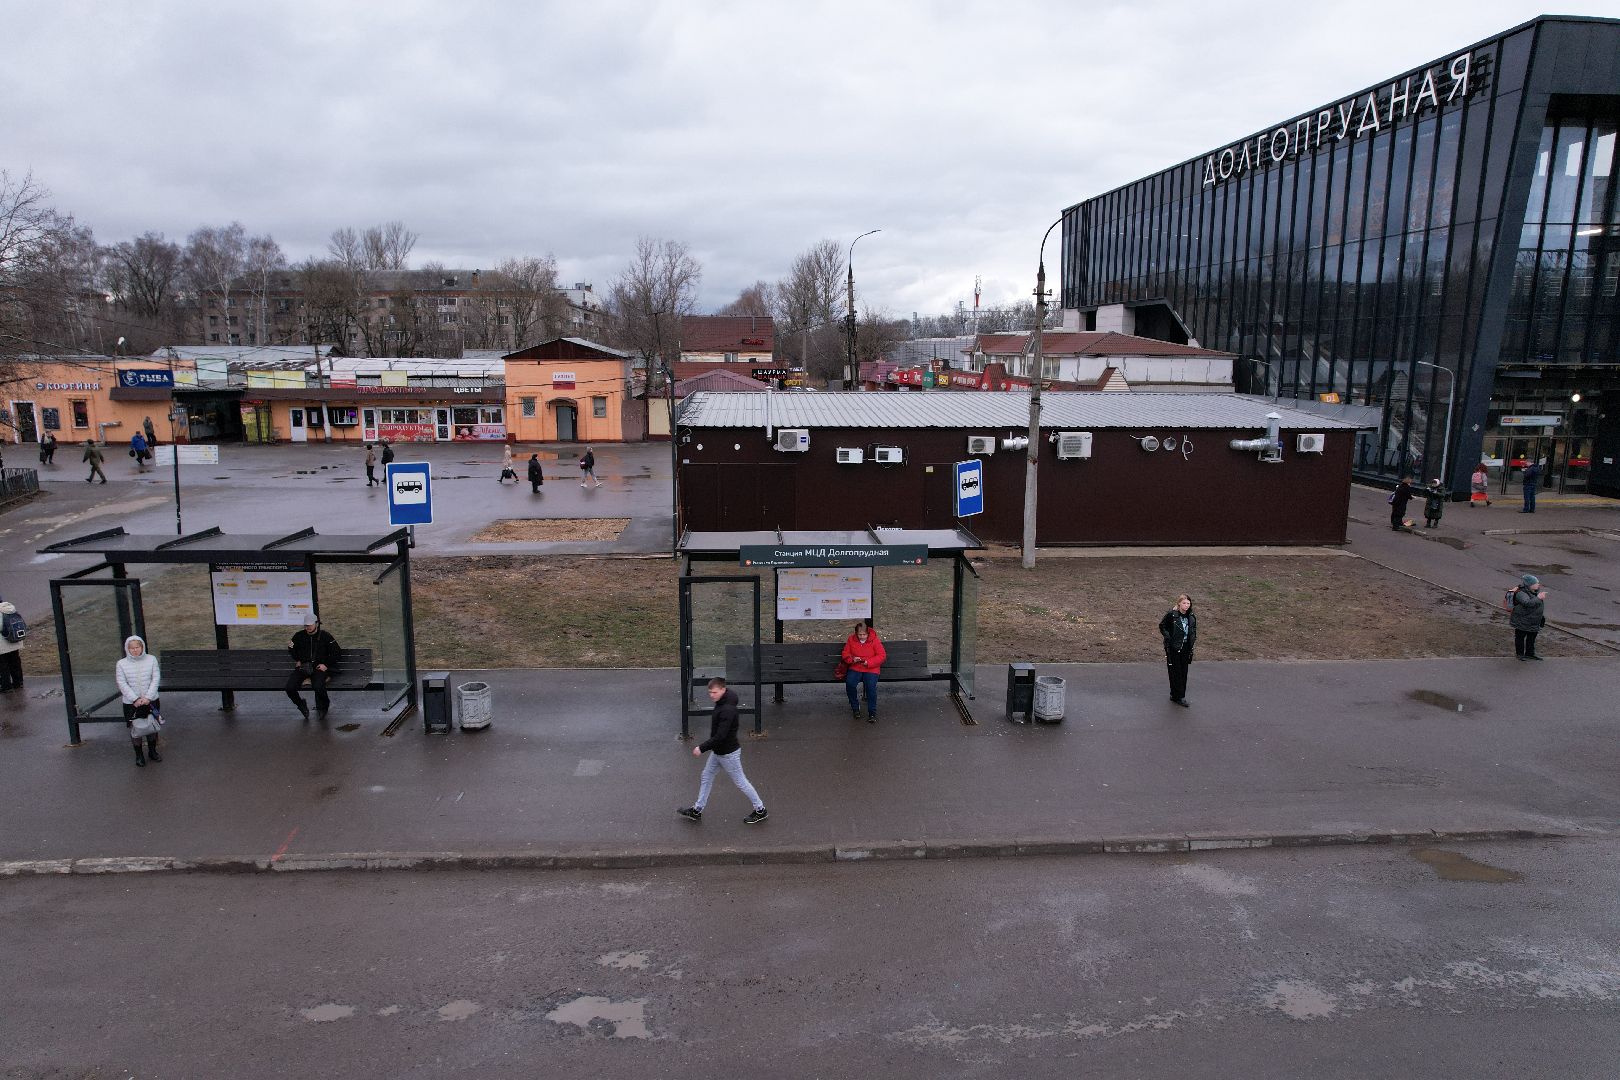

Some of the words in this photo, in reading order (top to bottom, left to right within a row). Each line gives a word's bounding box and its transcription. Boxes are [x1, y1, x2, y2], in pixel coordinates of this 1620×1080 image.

[1203, 52, 1472, 188] ДОЛГОПРУДНАЯ
[139, 374, 169, 382] РЫБА
[46, 381, 100, 391] КОФЕЙНЯ
[774, 549, 803, 559] Станция
[804, 548, 826, 559] МЦД
[827, 548, 889, 559] Долгопрудная
